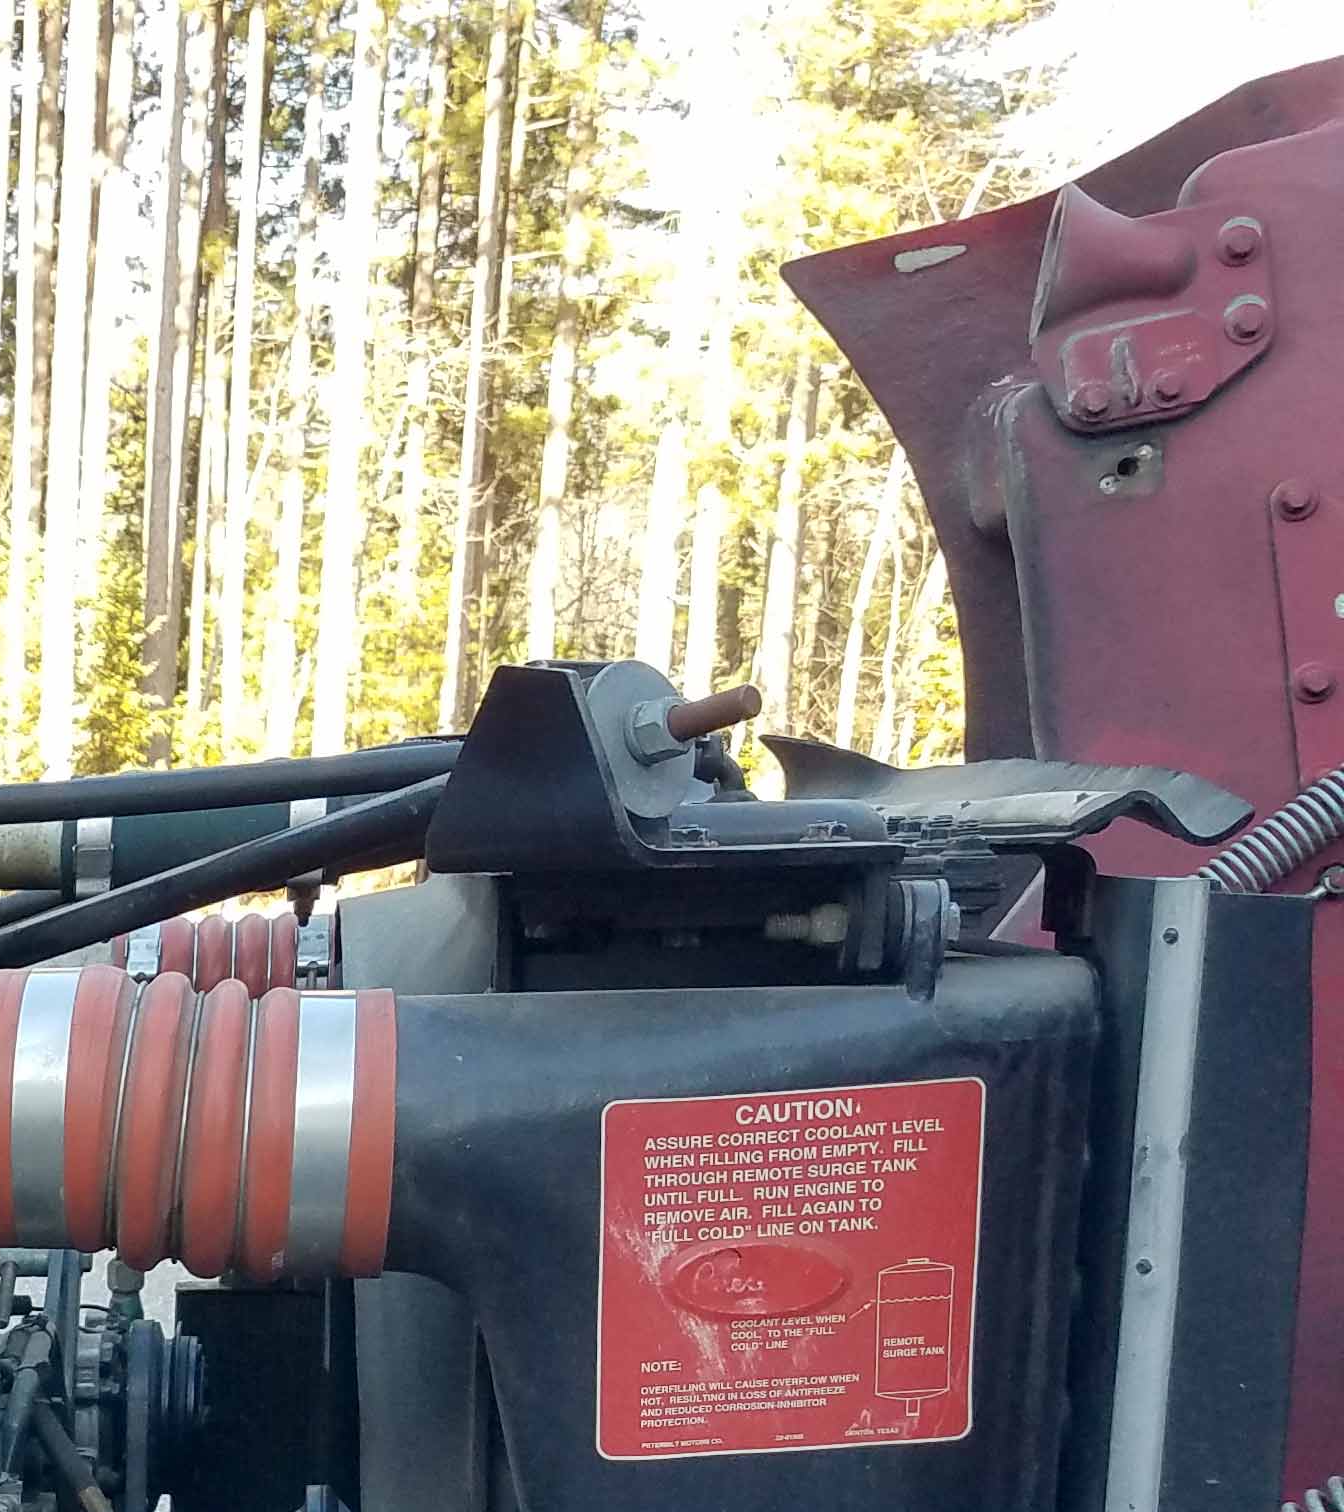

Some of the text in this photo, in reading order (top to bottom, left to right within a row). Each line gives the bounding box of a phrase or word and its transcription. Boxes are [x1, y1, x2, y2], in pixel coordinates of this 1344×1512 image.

[644, 1118, 944, 1151] ASSURE CORRECT COOLANT LEVEL
[644, 1138, 928, 1169] WHEN FILLING FROM EMPTY. FILL
[644, 1157, 918, 1188] THROUGH REMOTE SURGE TANK
[644, 1191, 692, 1207] UNTIL
[753, 1185, 788, 1200] RUN
[794, 1181, 857, 1197] ENGINE
[861, 1179, 885, 1193] TO
[644, 1197, 882, 1225] REMOVE AIR. FILL AGAIN TO
[644, 1216, 878, 1243] "FULL COLD" LINE ON TANK.
[731, 1314, 846, 1329] COOLANT LEVEL WHEN
[768, 1329, 782, 1338] TO
[783, 1327, 801, 1337] THE
[766, 1339, 789, 1350] LINE
[883, 1336, 925, 1347] REMOTE
[883, 1346, 944, 1359] SURGE TANK
[641, 1361, 681, 1373] NOTE:
[640, 1373, 860, 1395] OVERFILLING WILL CAUSE OVERFLOW WHEN
[640, 1385, 846, 1407] HOT. RESULTING IN LOSS OF ANTIFREEZE
[640, 1408, 662, 1418] AND
[665, 1404, 712, 1416] REDUCED
